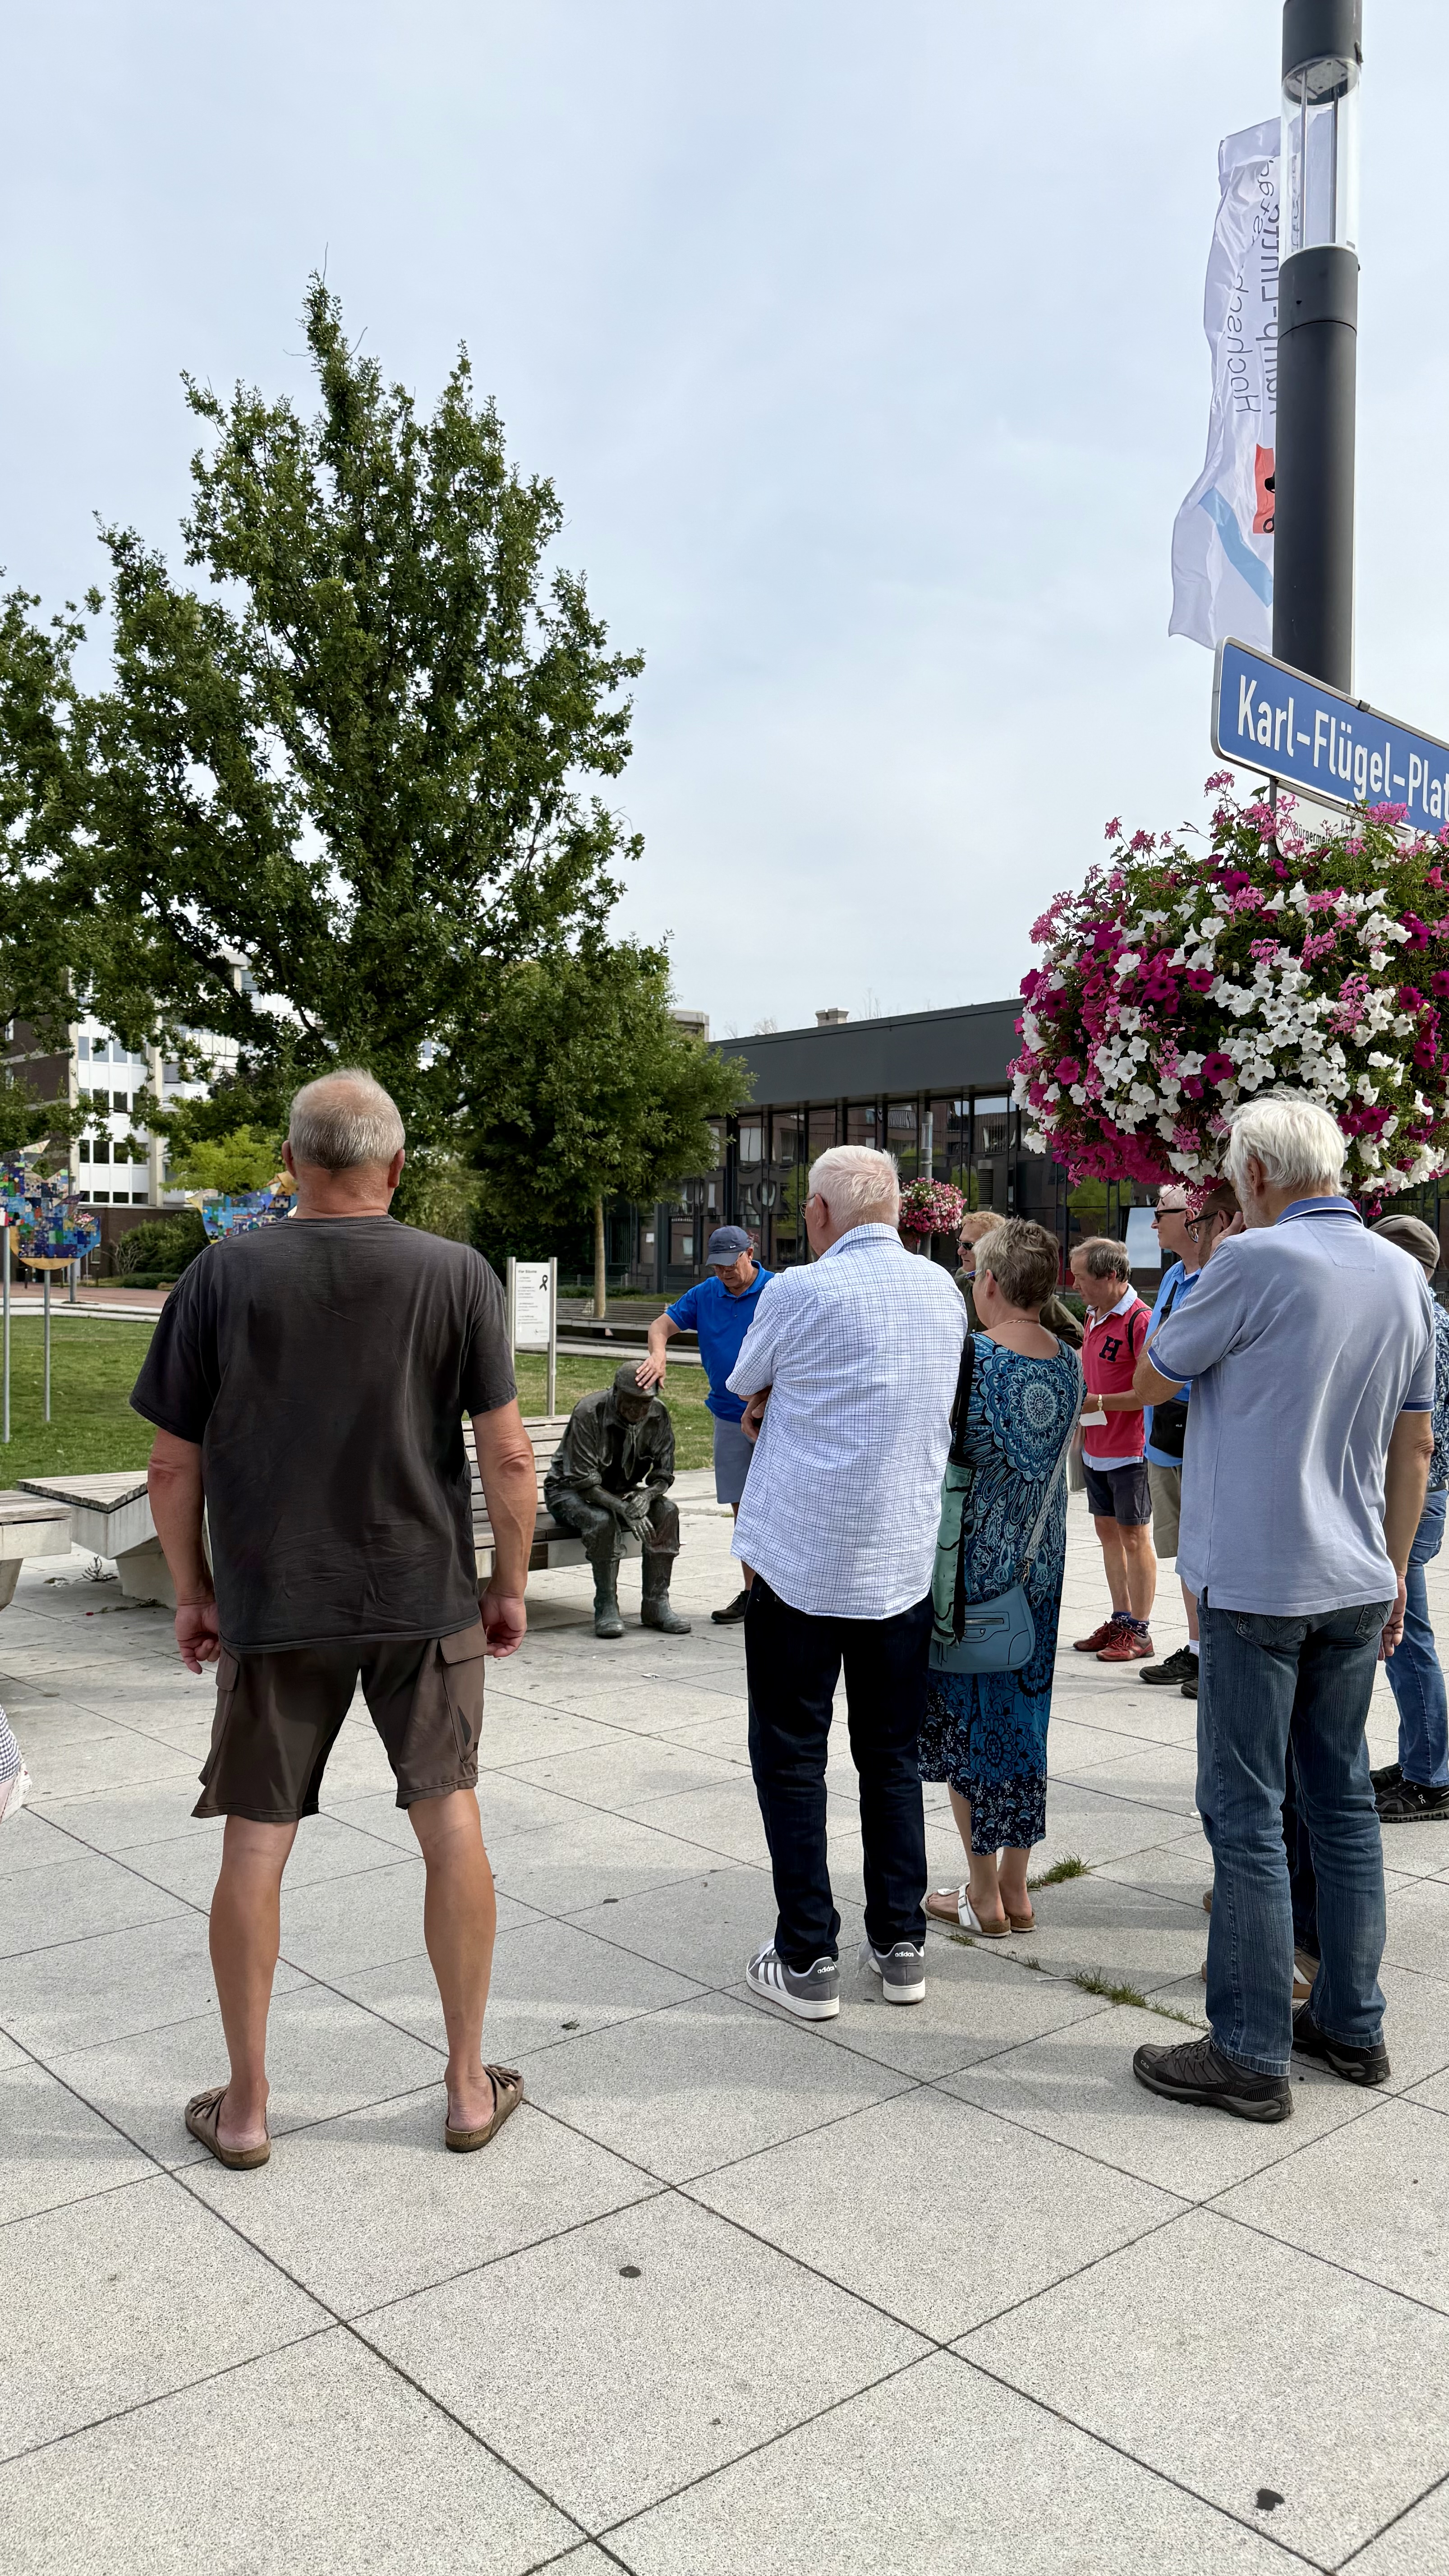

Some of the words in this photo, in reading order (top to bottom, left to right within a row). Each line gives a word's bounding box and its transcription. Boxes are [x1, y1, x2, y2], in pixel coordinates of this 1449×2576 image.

[1237, 675, 1449, 822] Karl-Flügel-Plat
[1294, 822, 1332, 845] Bürgermei
[1099, 1335, 1123, 1362] H
